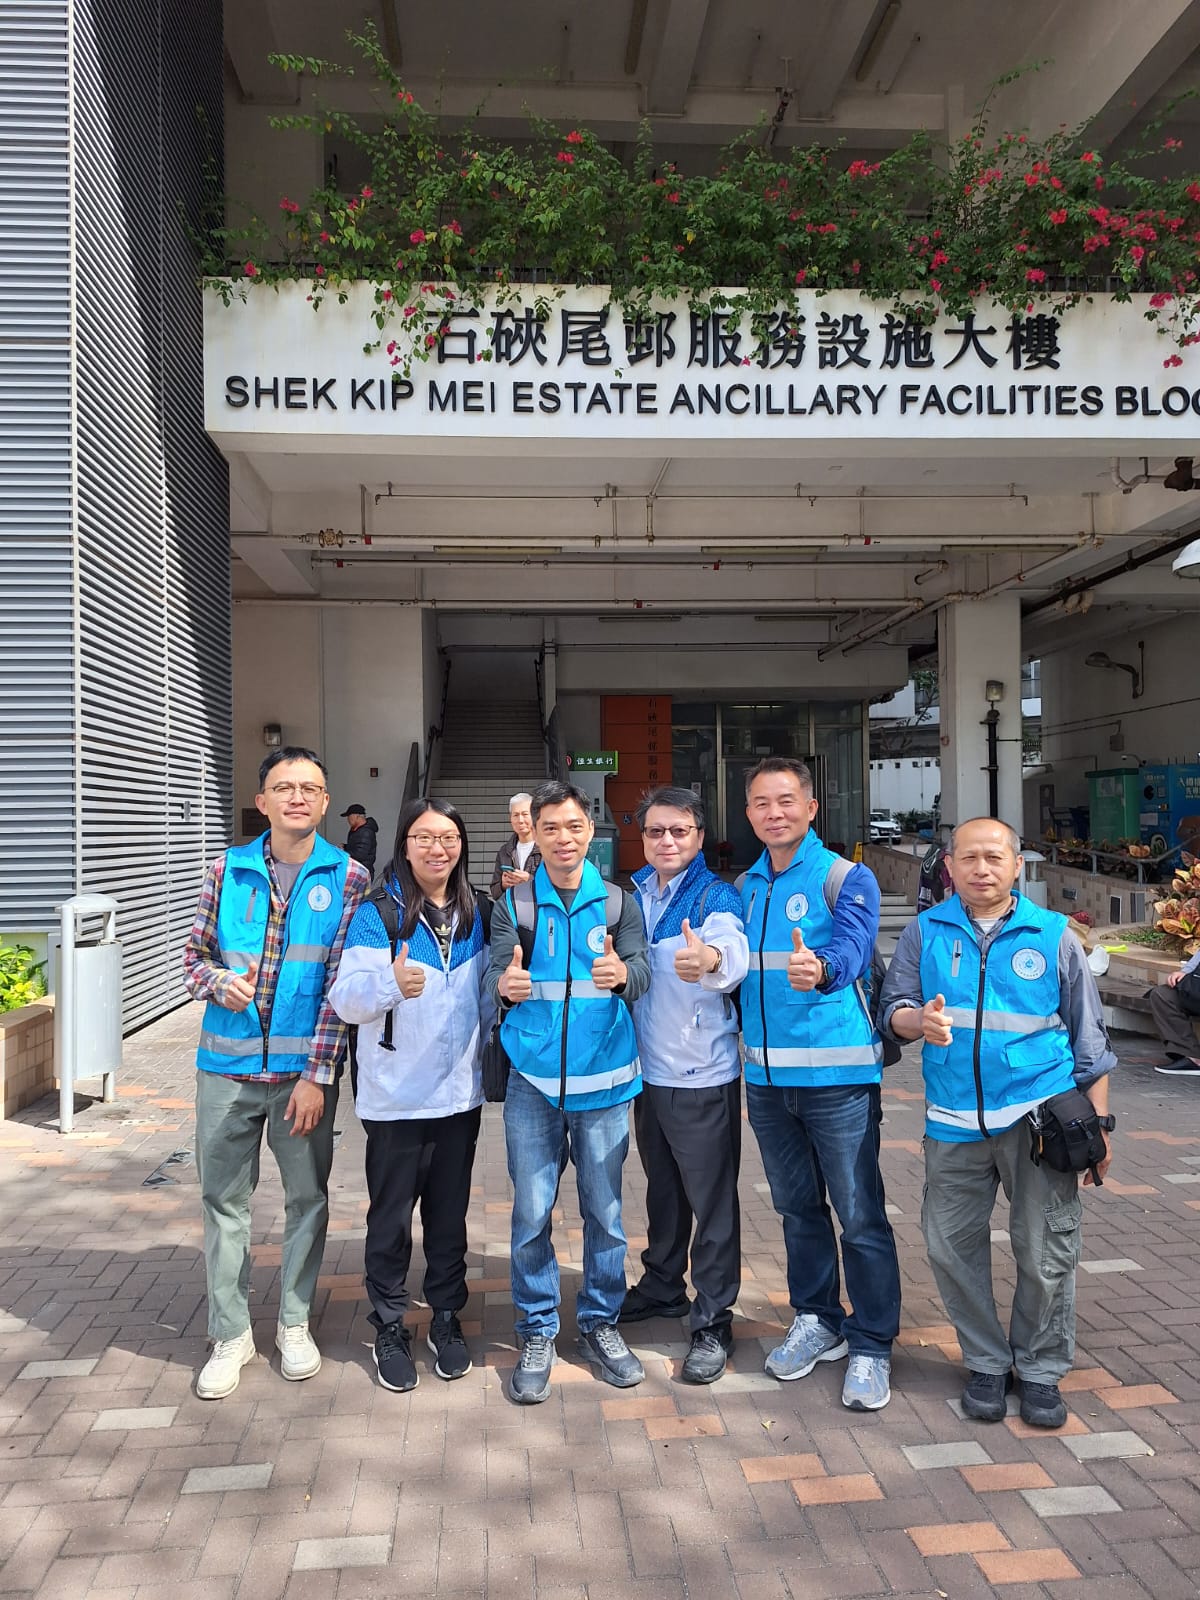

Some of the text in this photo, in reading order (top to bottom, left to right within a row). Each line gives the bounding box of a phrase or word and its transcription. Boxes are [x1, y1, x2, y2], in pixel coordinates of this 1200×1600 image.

[425, 308, 1062, 370] 石硤尾邨服務設施大樓
[225, 375, 338, 410] SHEK
[351, 378, 415, 411] KIP
[428, 380, 496, 413] MEI
[512, 381, 658, 414] ESTATE
[669, 383, 888, 416] ANCILLARY
[900, 384, 1104, 417] FACILITIES
